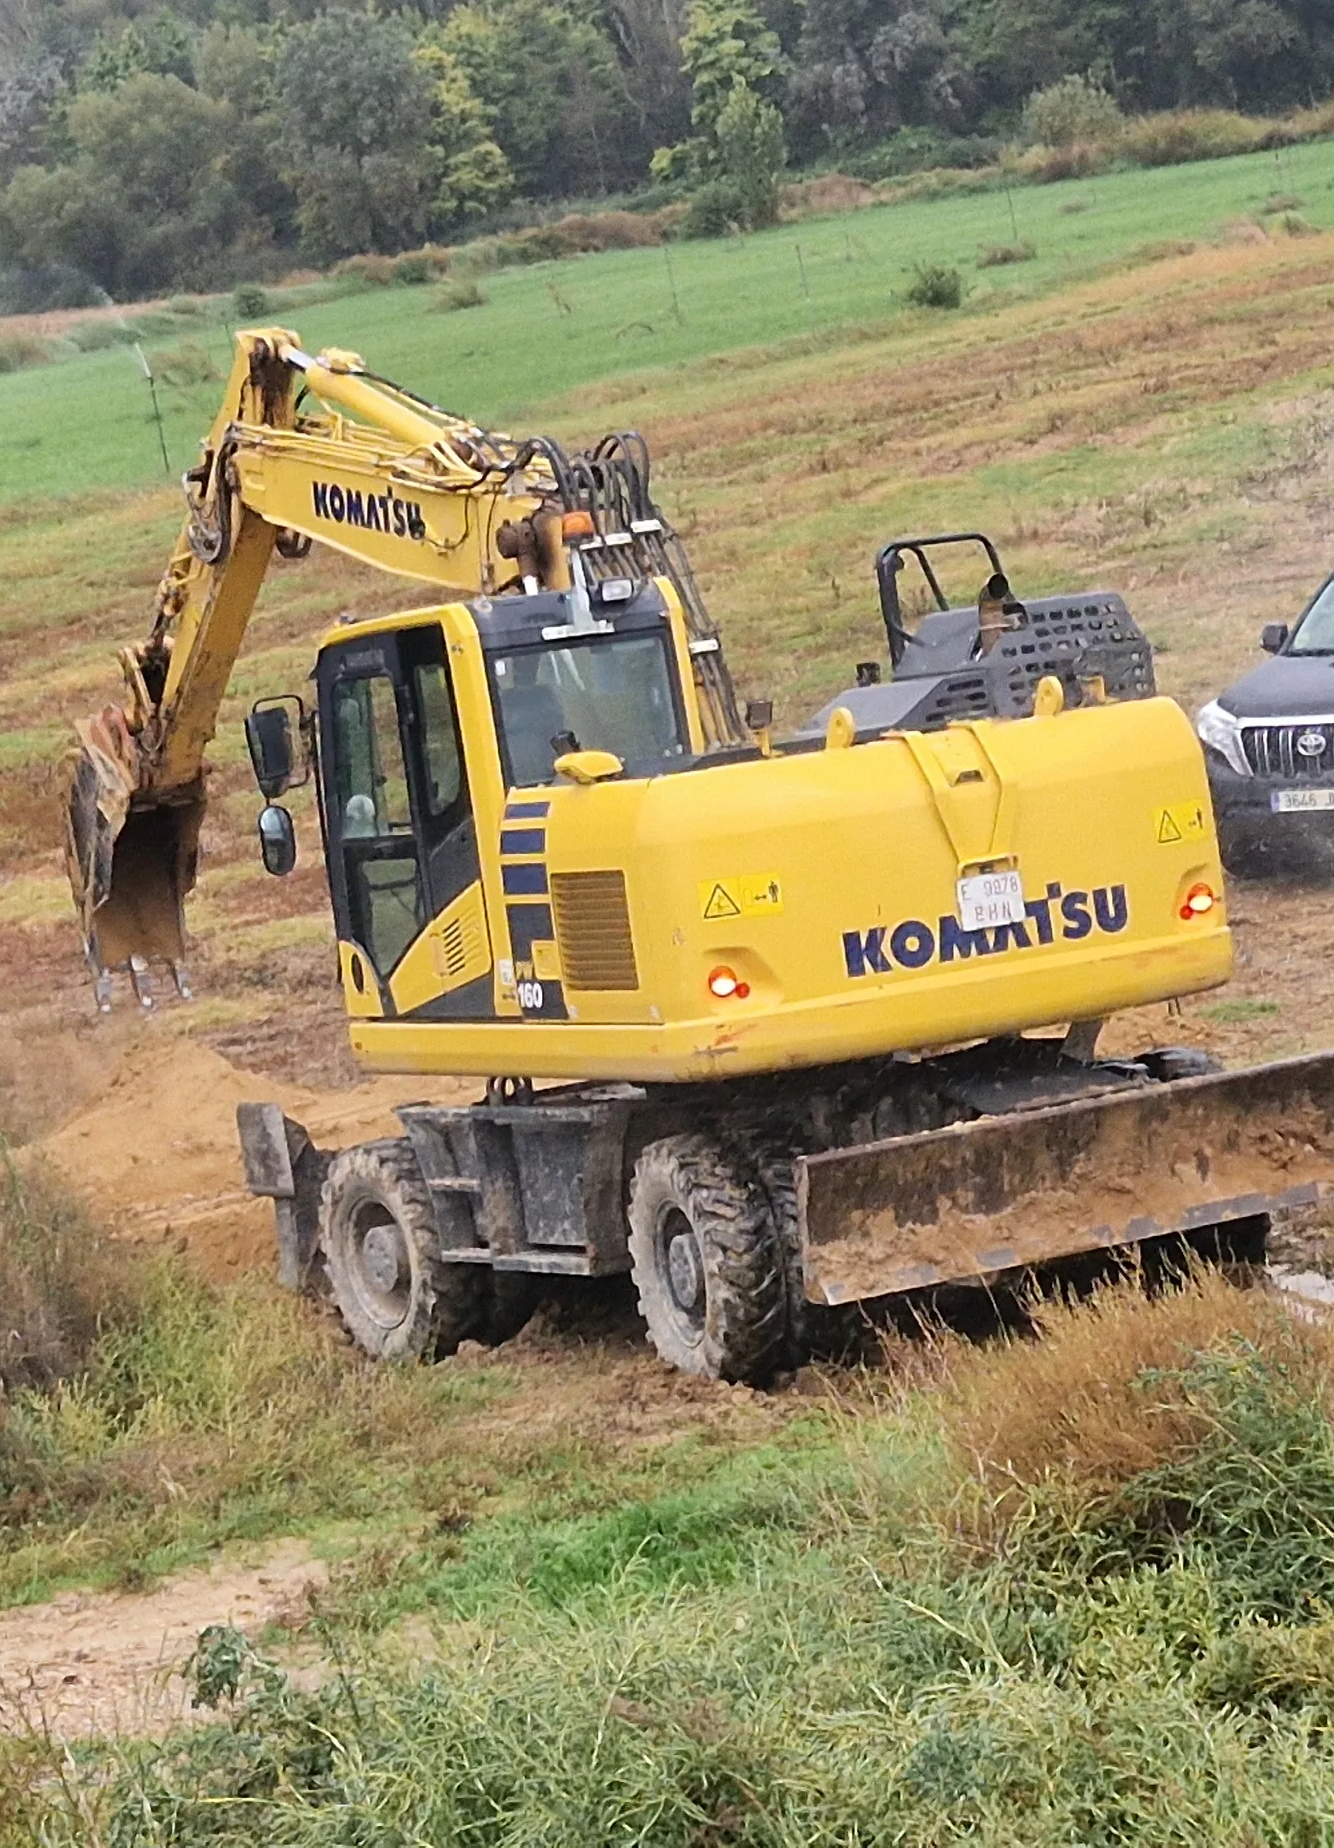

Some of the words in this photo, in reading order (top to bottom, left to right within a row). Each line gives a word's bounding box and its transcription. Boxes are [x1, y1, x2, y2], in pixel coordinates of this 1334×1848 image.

[312, 481, 425, 540] KOMATSU
[961, 883, 972, 900] E
[842, 881, 1128, 978] KOMATSU
[518, 982, 543, 1009] 160
